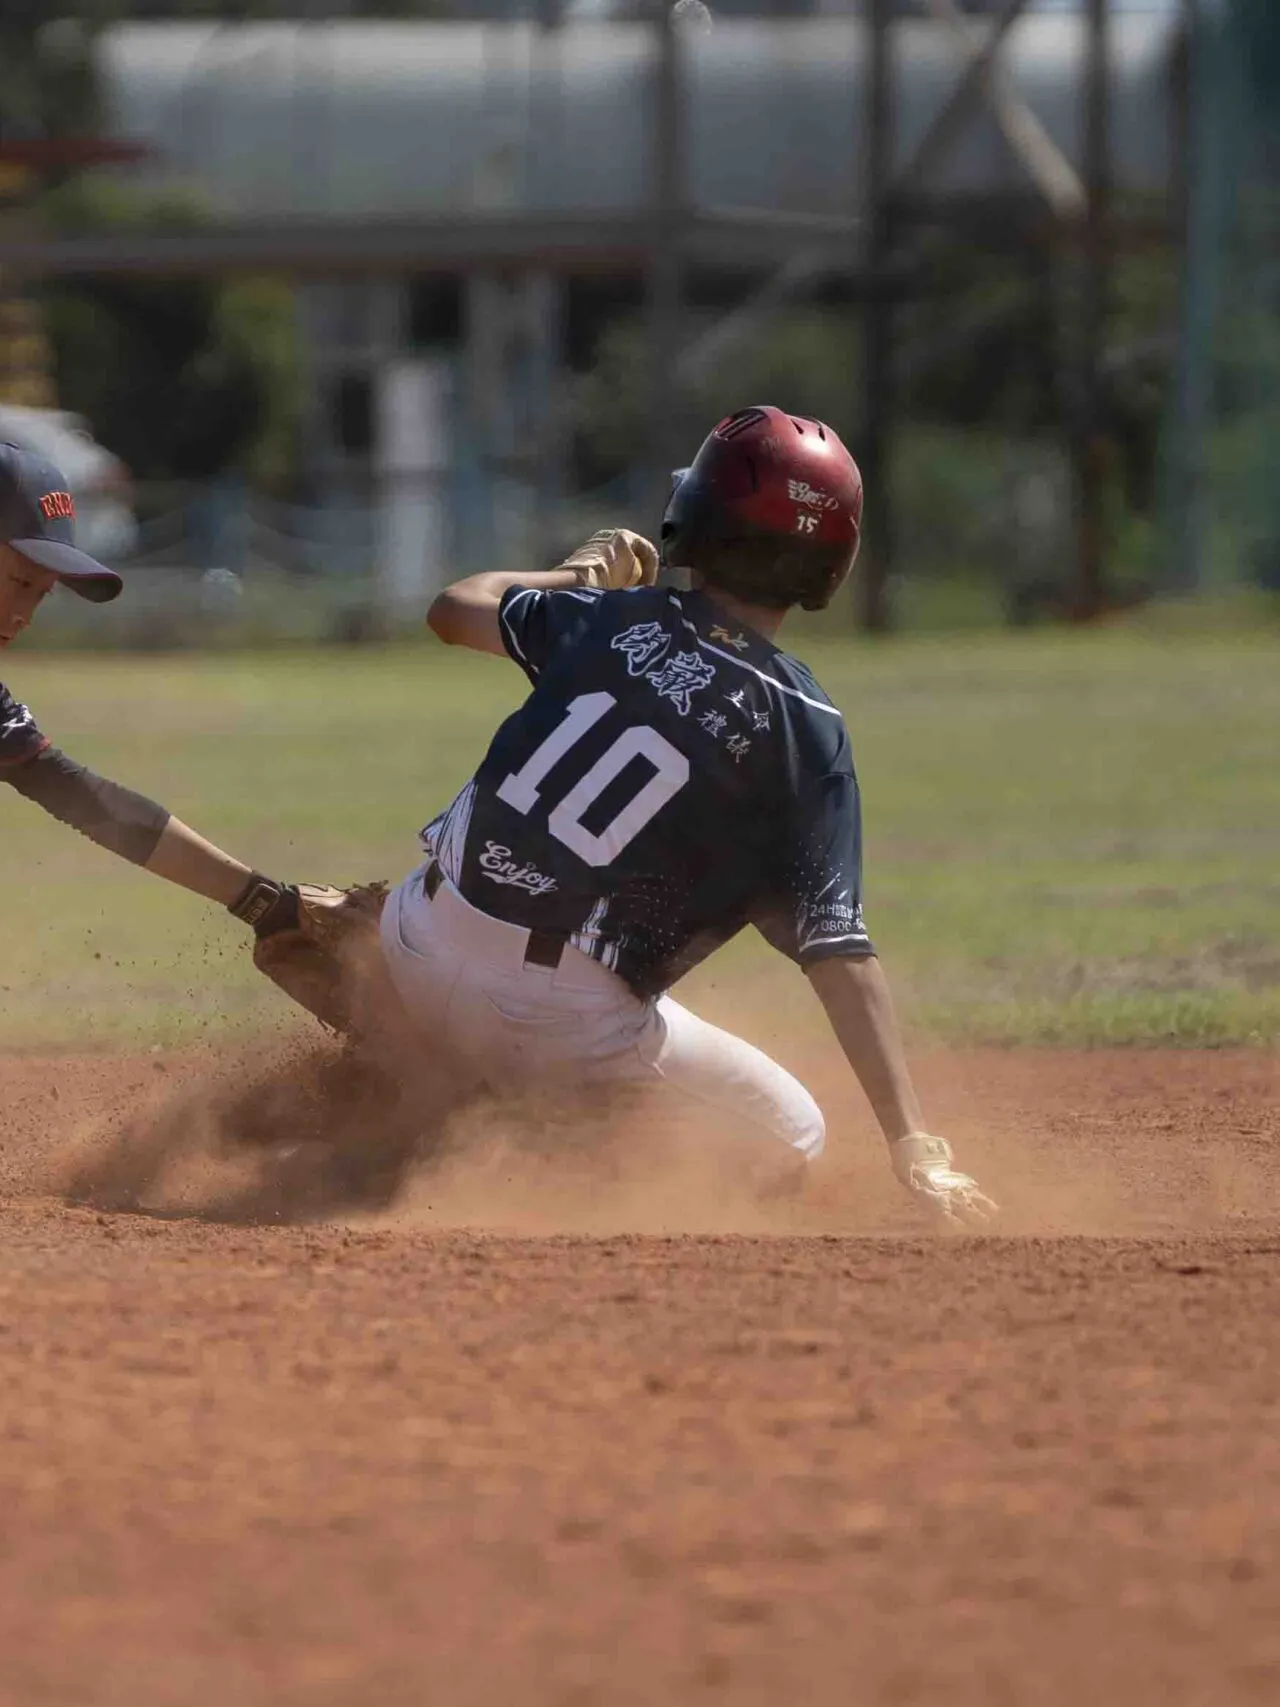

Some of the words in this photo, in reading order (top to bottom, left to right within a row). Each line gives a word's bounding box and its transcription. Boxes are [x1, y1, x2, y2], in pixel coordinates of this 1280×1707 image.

[797, 515, 818, 534] 15
[495, 691, 690, 868] 10
[479, 840, 559, 896] Enjoy
